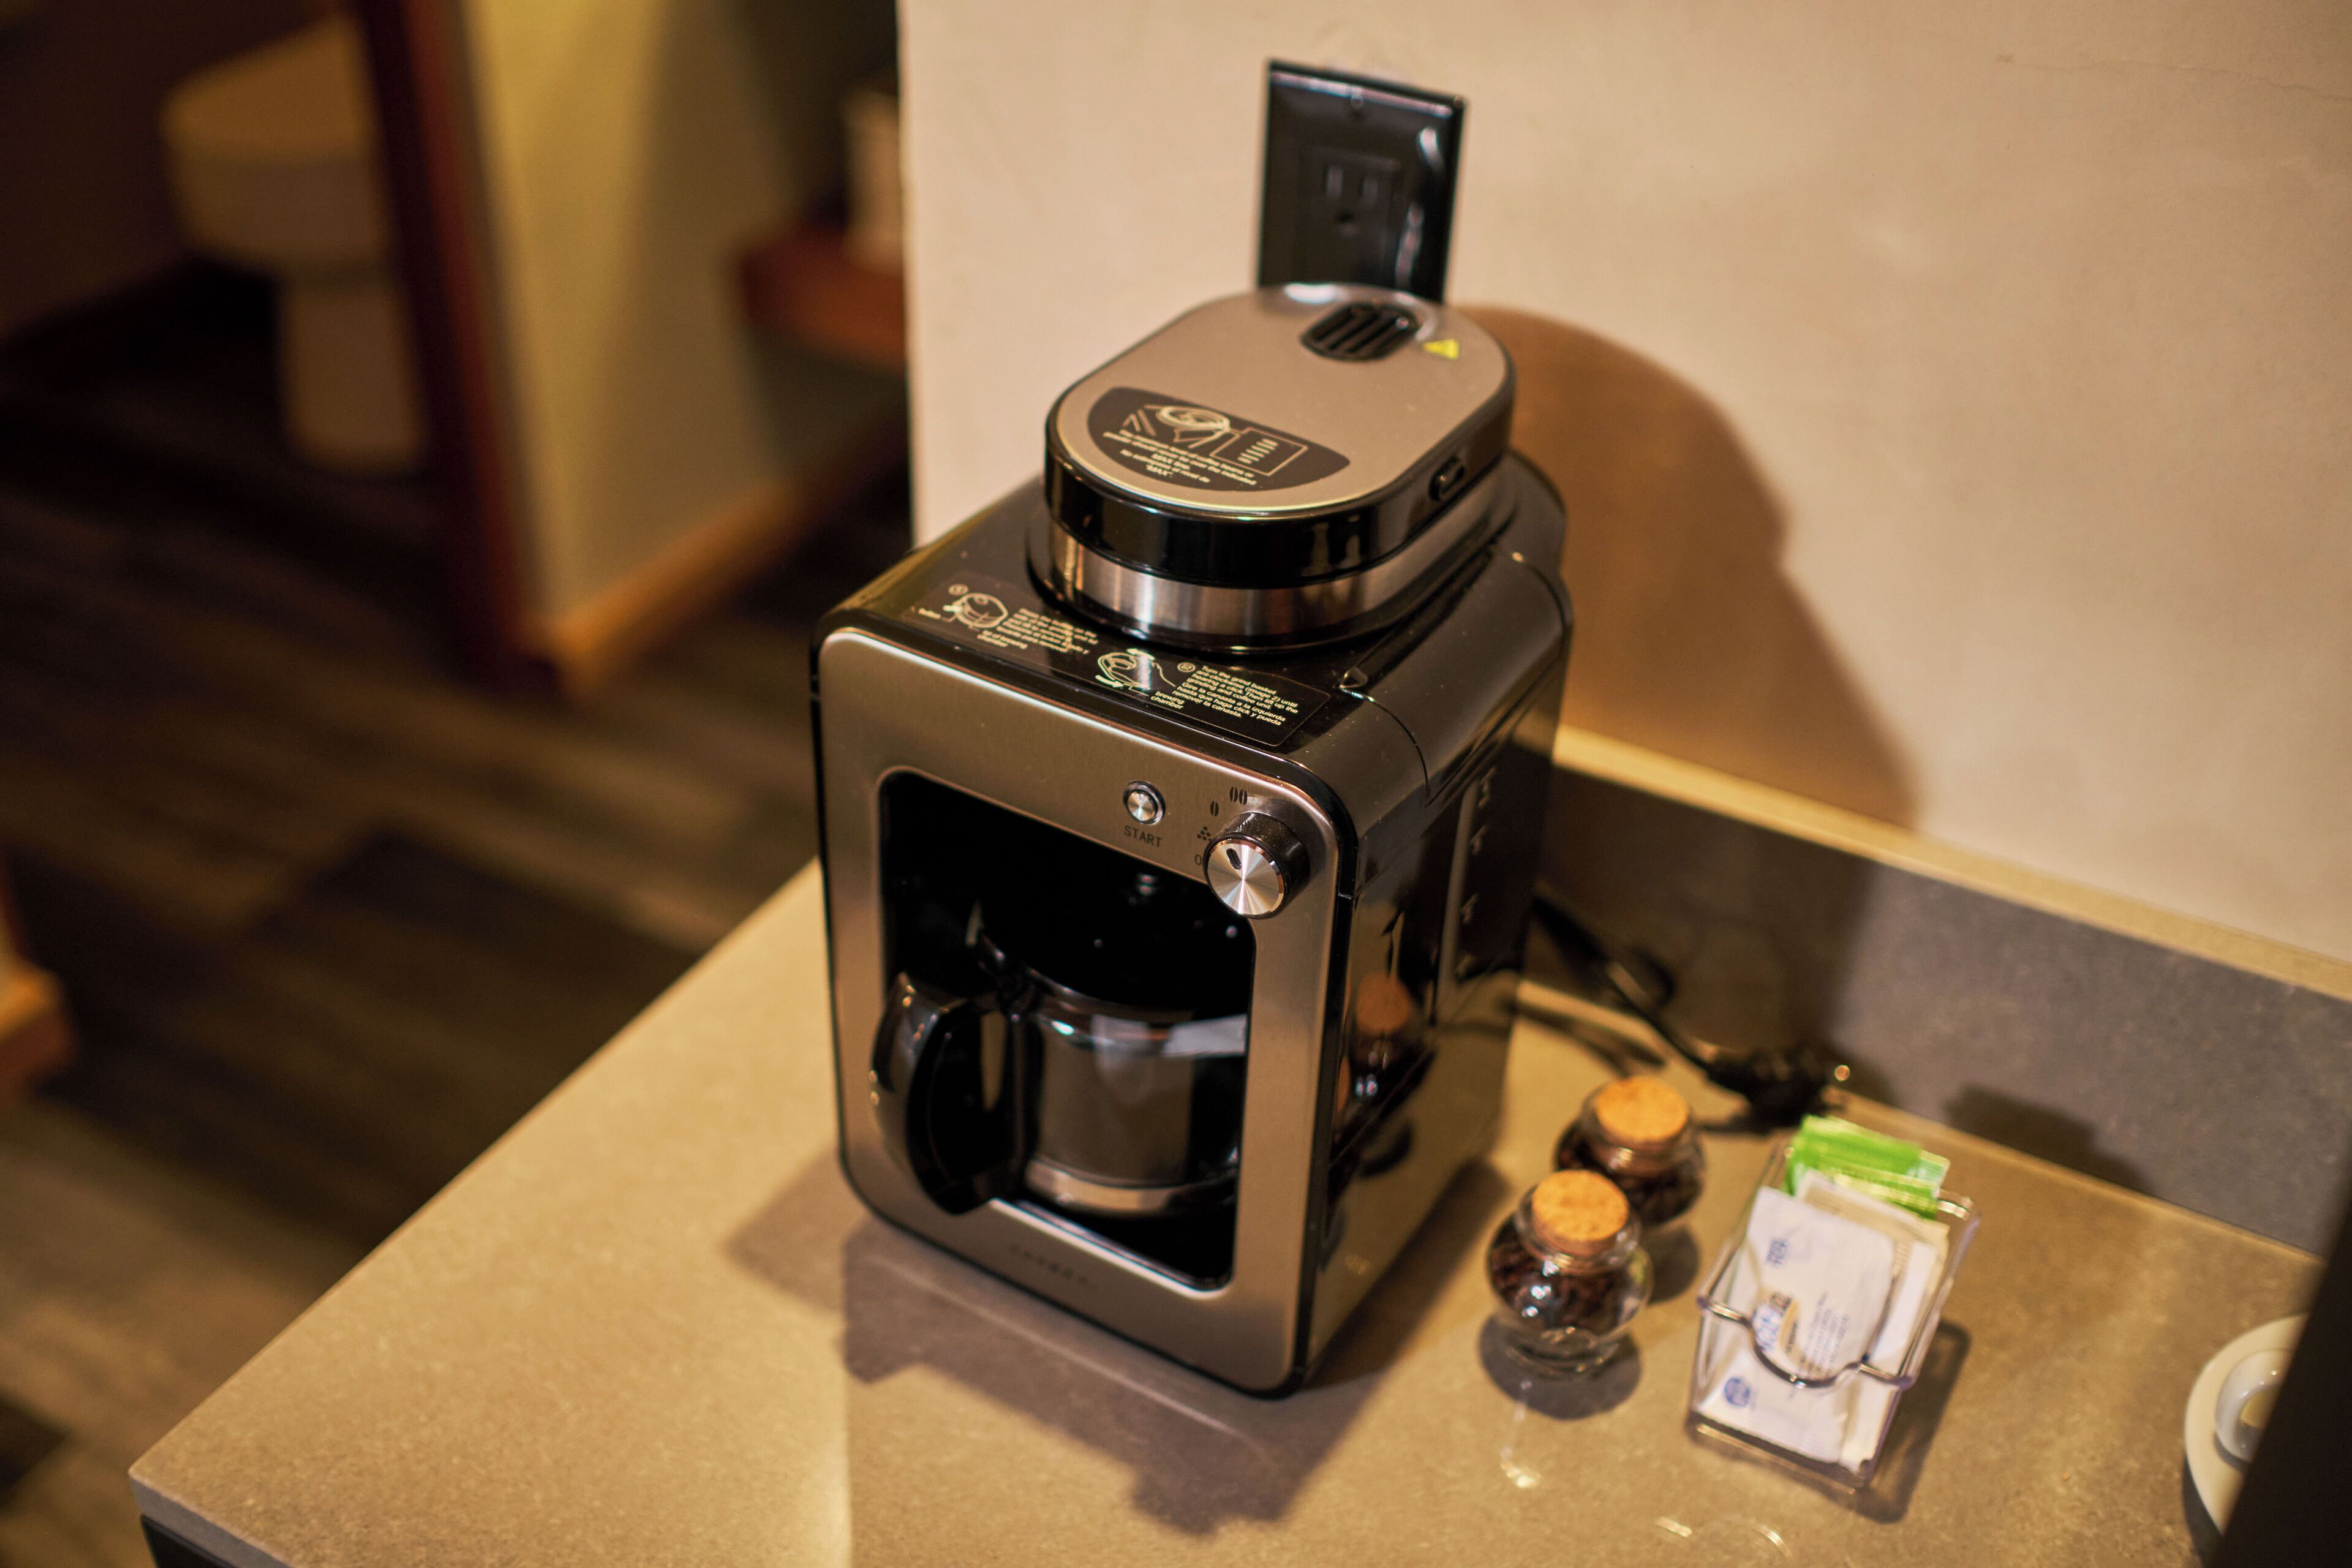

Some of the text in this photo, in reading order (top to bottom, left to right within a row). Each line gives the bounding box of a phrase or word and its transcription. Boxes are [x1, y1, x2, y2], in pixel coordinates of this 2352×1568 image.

[1186, 677, 1216, 691] grinding
[1232, 692, 1256, 704] coffee
[1192, 673, 1219, 686] hearing
[1245, 691, 1263, 701] Then
[1264, 696, 1274, 705] lift
[1286, 705, 1298, 714] the
[1202, 666, 1218, 674] Turn
[1231, 676, 1251, 687] grind
[1251, 683, 1276, 695] basket
[1151, 696, 1184, 709] chamber
[1155, 691, 1185, 705] brewing
[1172, 690, 1204, 704] remover
[1212, 704, 1242, 718] canasta.
[1177, 685, 1198, 696] hasta
[1198, 693, 1213, 703] que
[1213, 698, 1233, 709] haga
[1233, 705, 1250, 715] click
[1256, 714, 1281, 726] pueda
[1207, 691, 1236, 704] canasta
[1251, 706, 1286, 722] izquierda
[1245, 687, 1271, 699] (image
[1281, 699, 1298, 707] until
[1124, 825, 1162, 847] START
